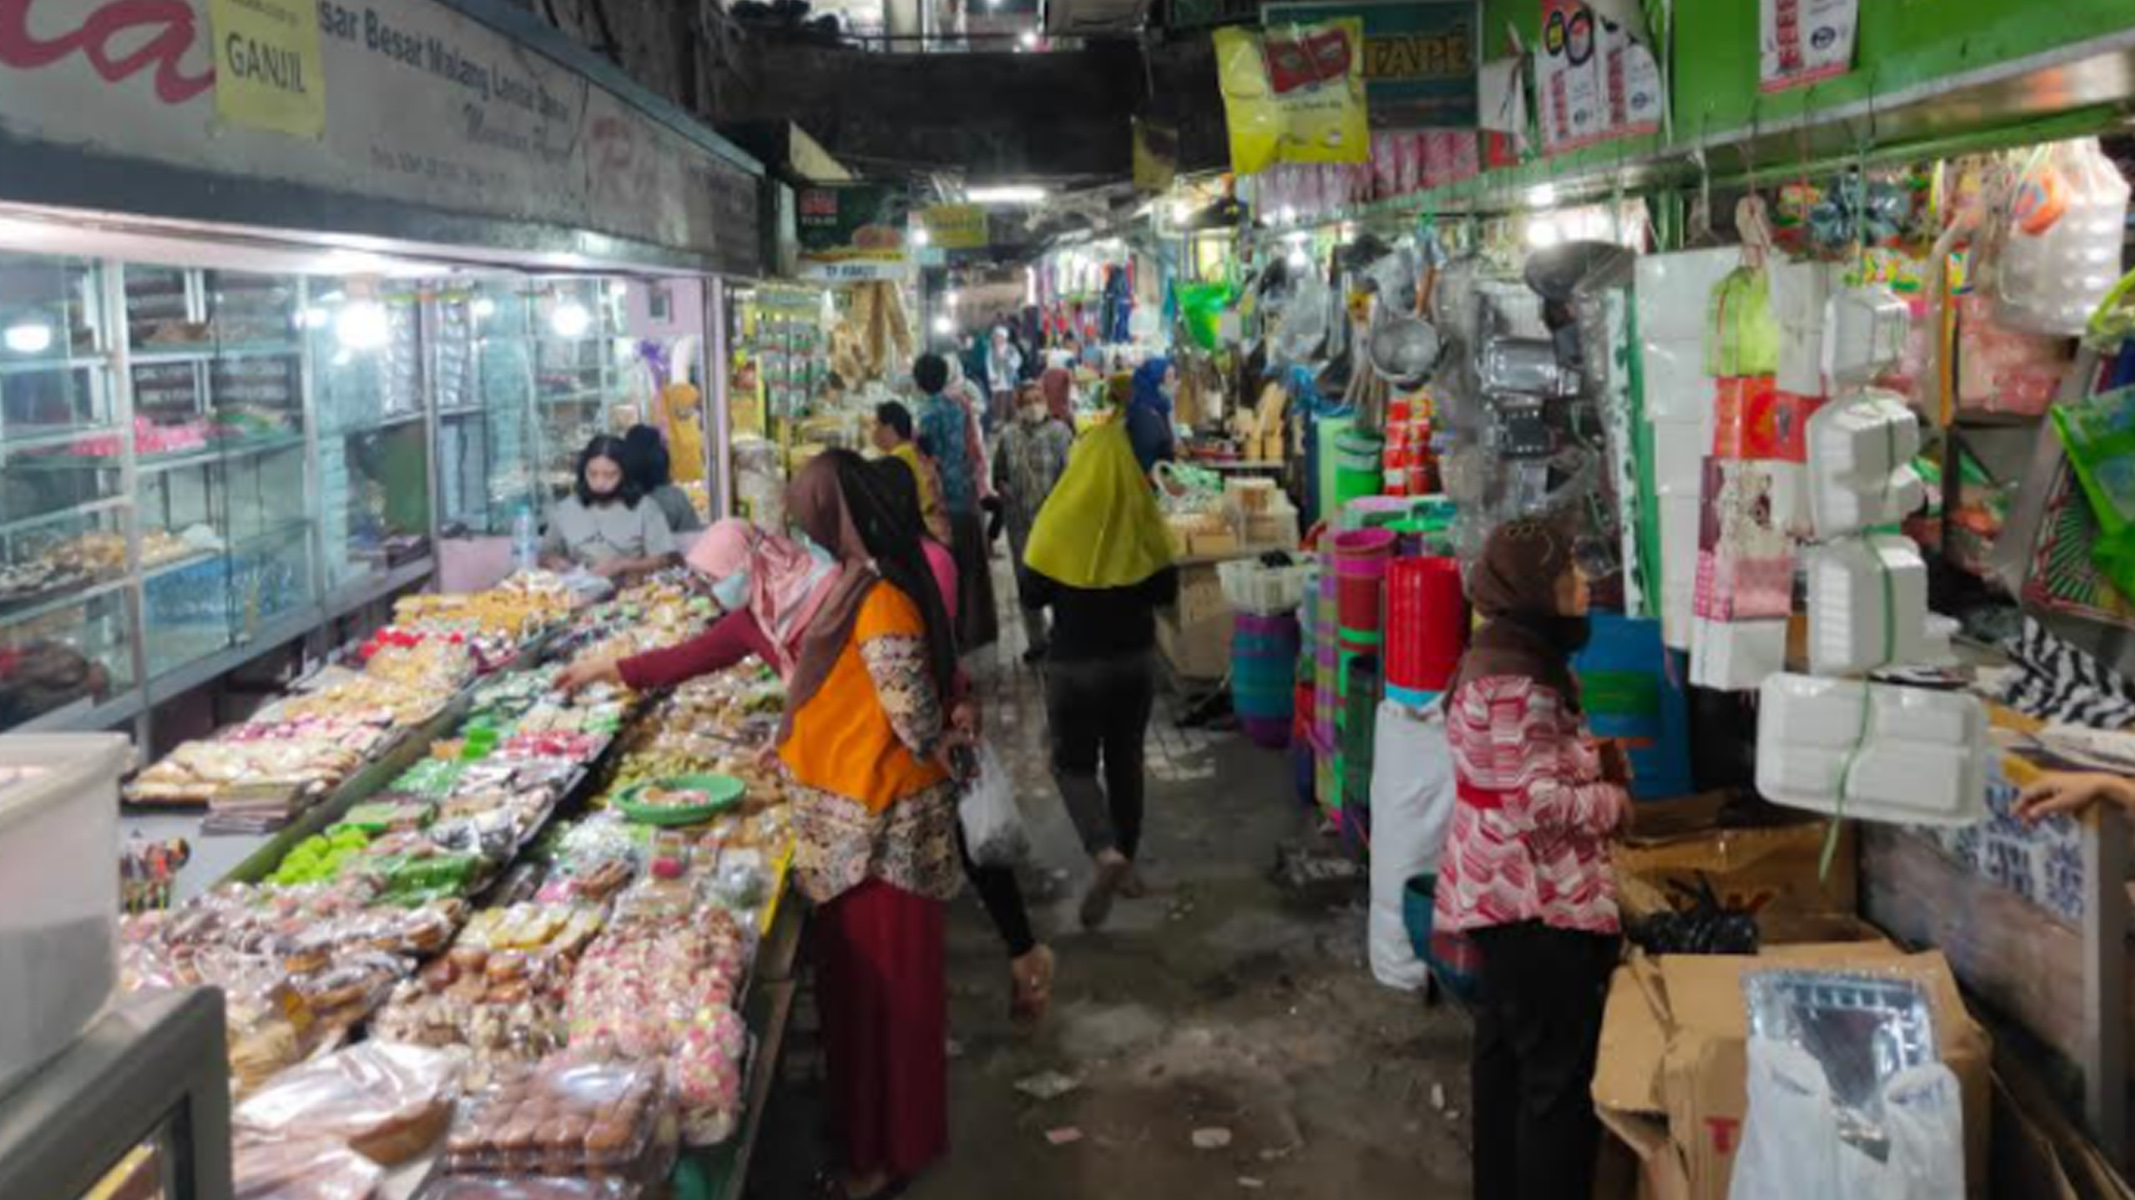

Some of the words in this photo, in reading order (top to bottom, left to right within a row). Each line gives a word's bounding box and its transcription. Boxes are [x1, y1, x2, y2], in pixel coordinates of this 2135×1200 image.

[226, 31, 306, 94] GANJIL
[364, 7, 423, 68] Besar
[426, 38, 490, 102] Malang
